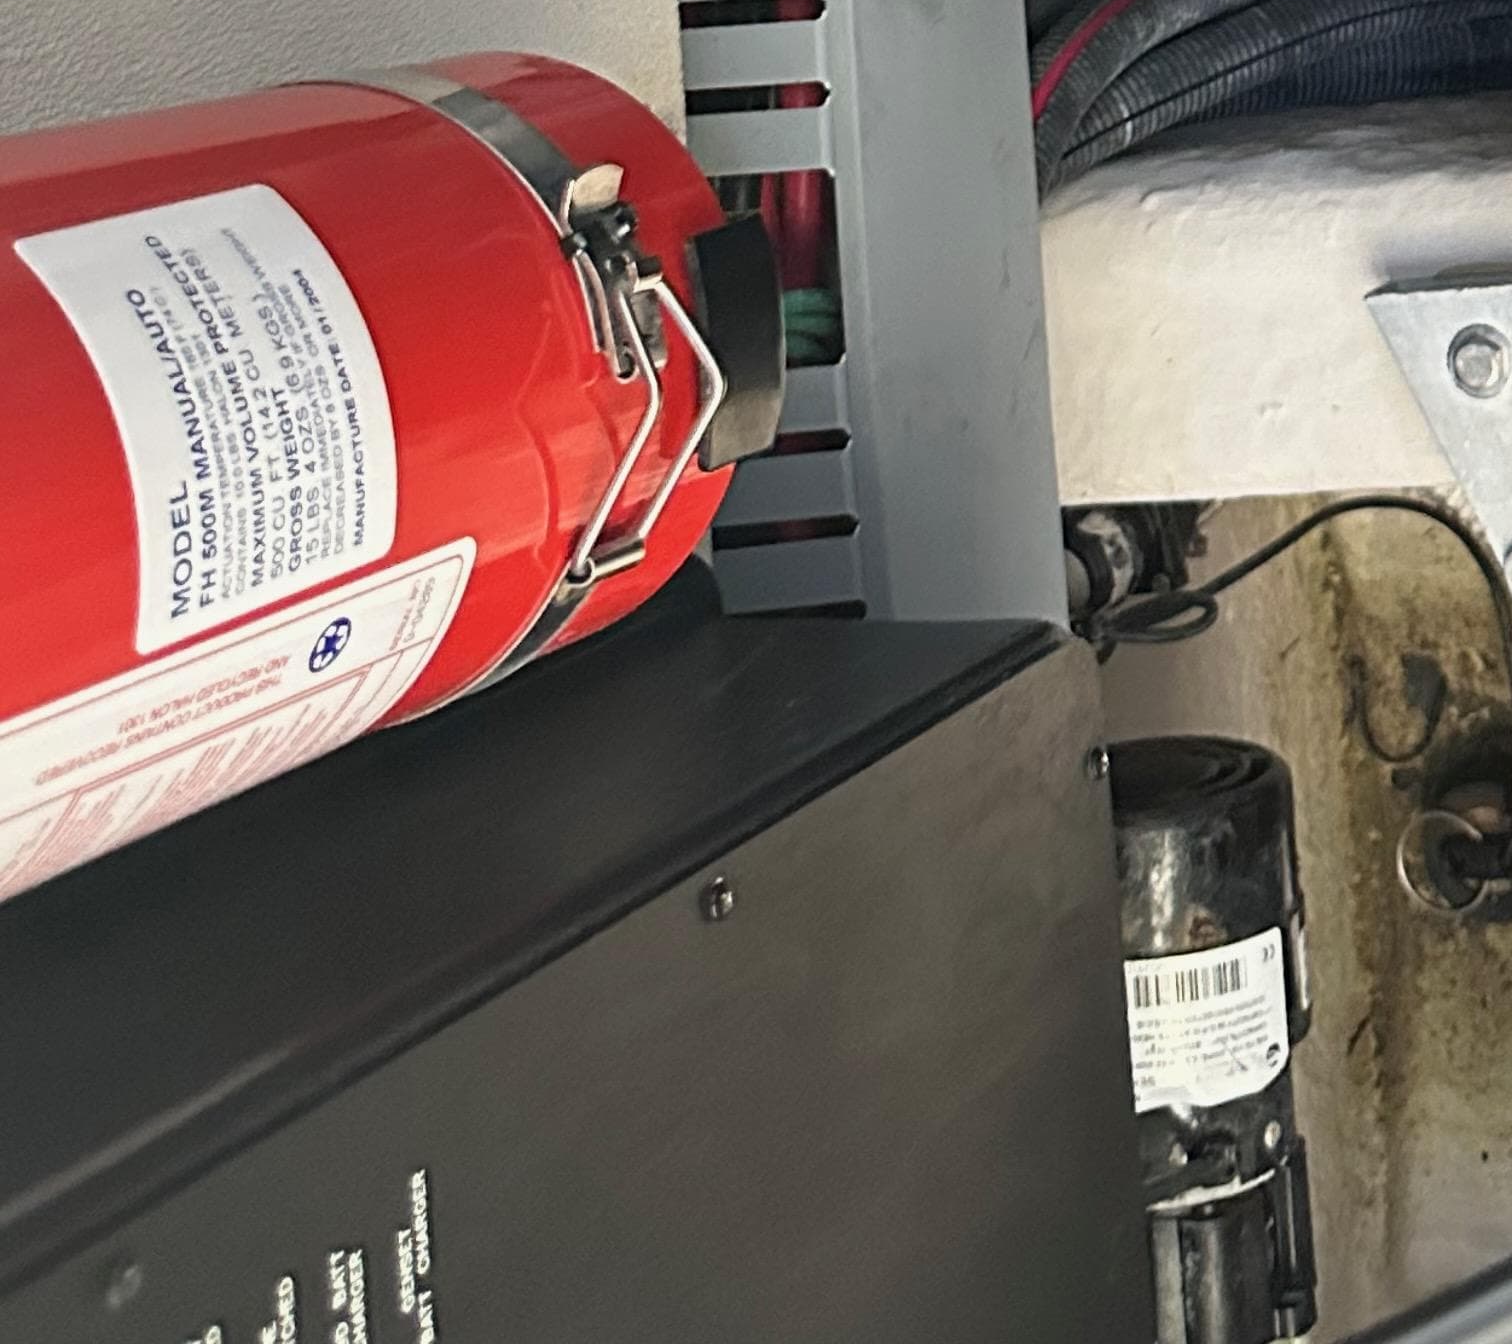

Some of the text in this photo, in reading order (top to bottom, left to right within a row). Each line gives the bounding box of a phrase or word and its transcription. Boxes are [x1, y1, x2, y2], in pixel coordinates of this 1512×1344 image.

[127, 290, 216, 607] FH 500M MANUAL/AUTO
[145, 236, 265, 586] MAXIMUM VOLUME PROTECTED
[328, 420, 340, 440] BY
[271, 388, 302, 571] GROSS WEIGHT
[305, 462, 316, 472] 4
[345, 398, 365, 546] MANUFACTURE
[170, 481, 192, 618] MODEL
[270, 536, 285, 578] 500
[306, 539, 319, 564] 15
[330, 1250, 347, 1311] BATT
[398, 1229, 416, 1314] GENSET
[411, 1169, 434, 1344] BATT CHARGER
